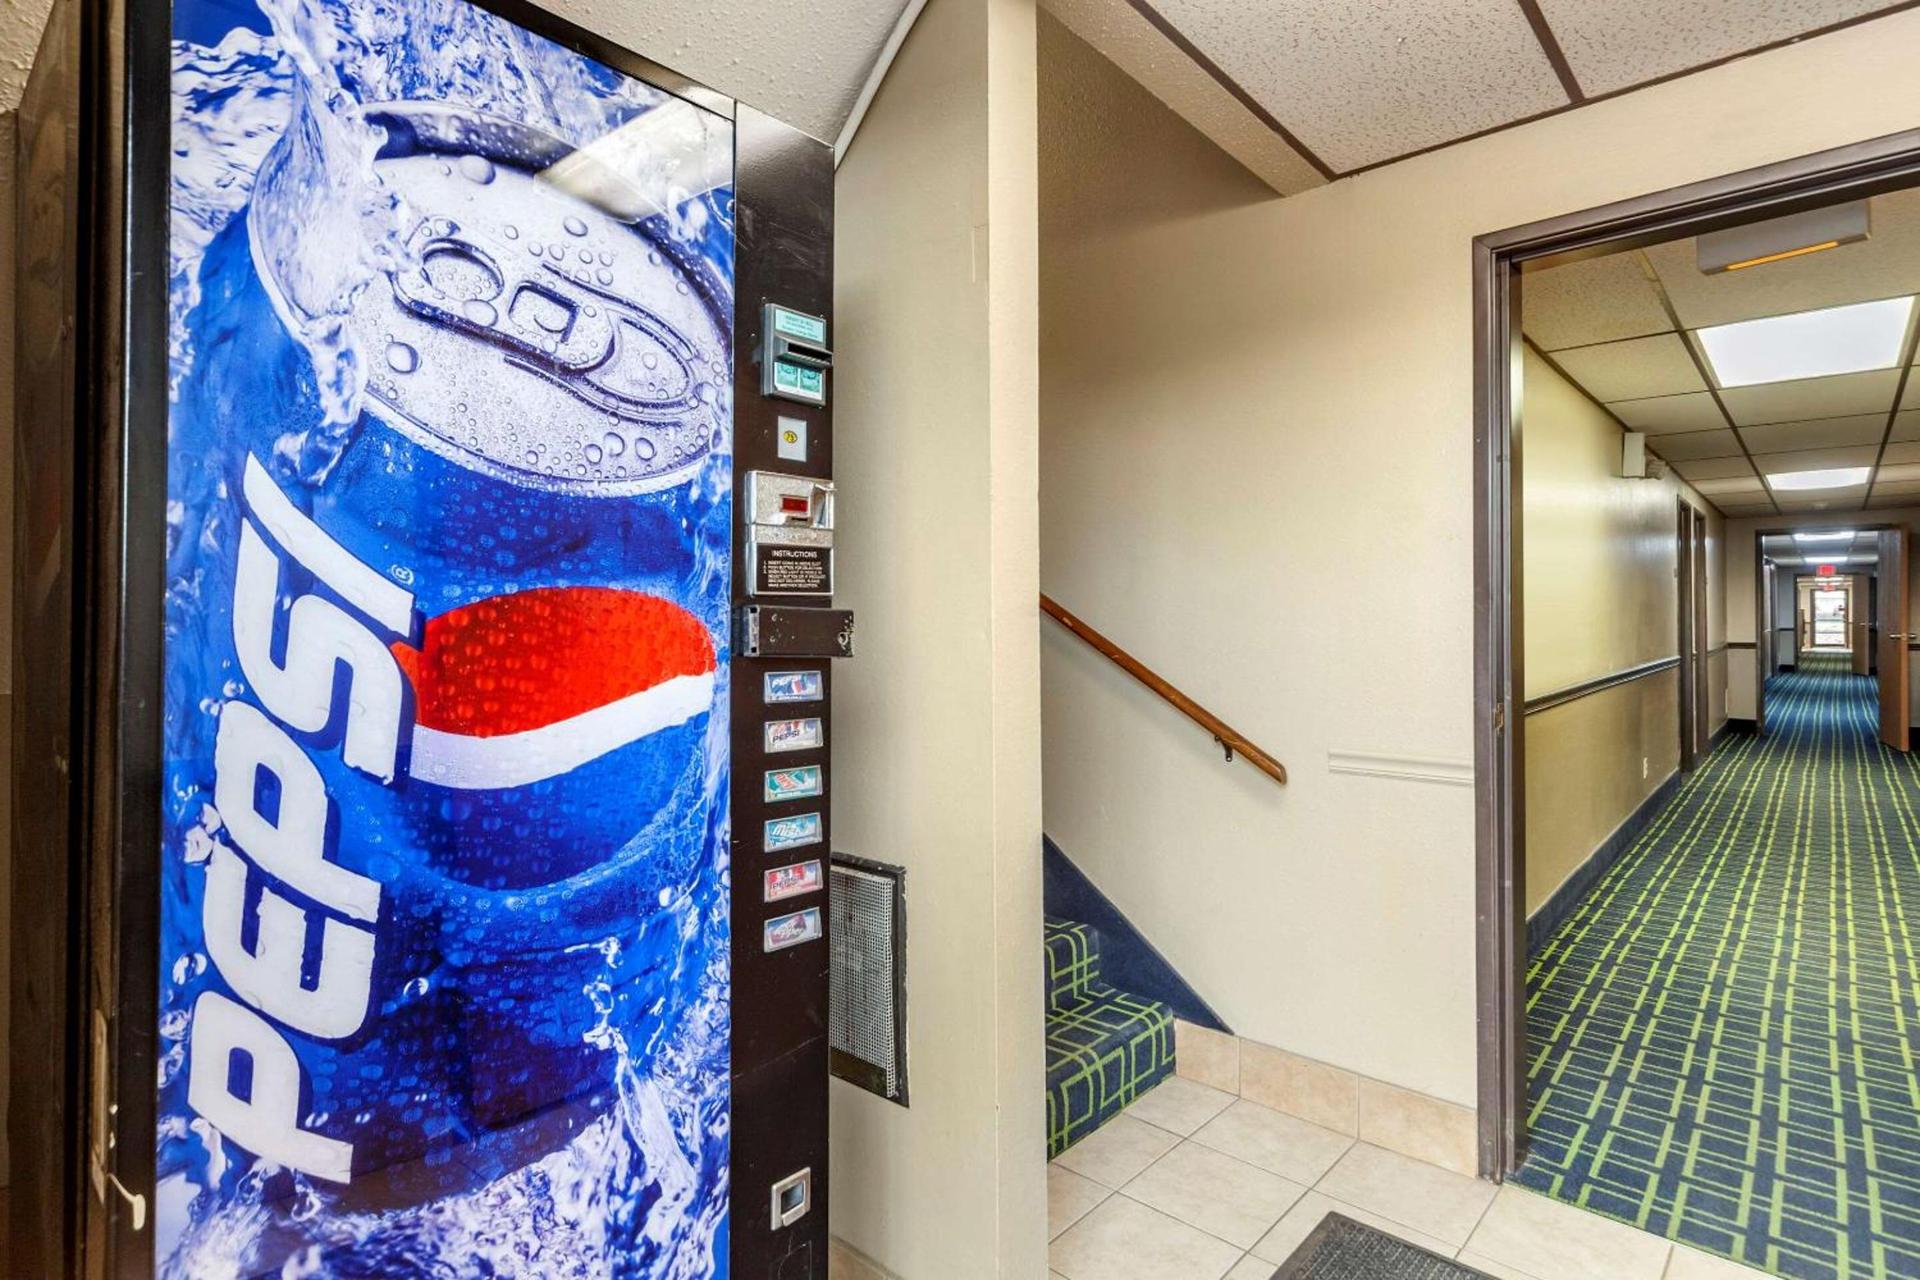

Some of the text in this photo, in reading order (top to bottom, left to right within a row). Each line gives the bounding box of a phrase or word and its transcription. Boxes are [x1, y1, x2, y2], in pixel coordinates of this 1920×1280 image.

[771, 550, 818, 558] INSTRUCTIONS
[772, 728, 801, 743] PEPSI
[188, 452, 414, 1184] PEPSI
